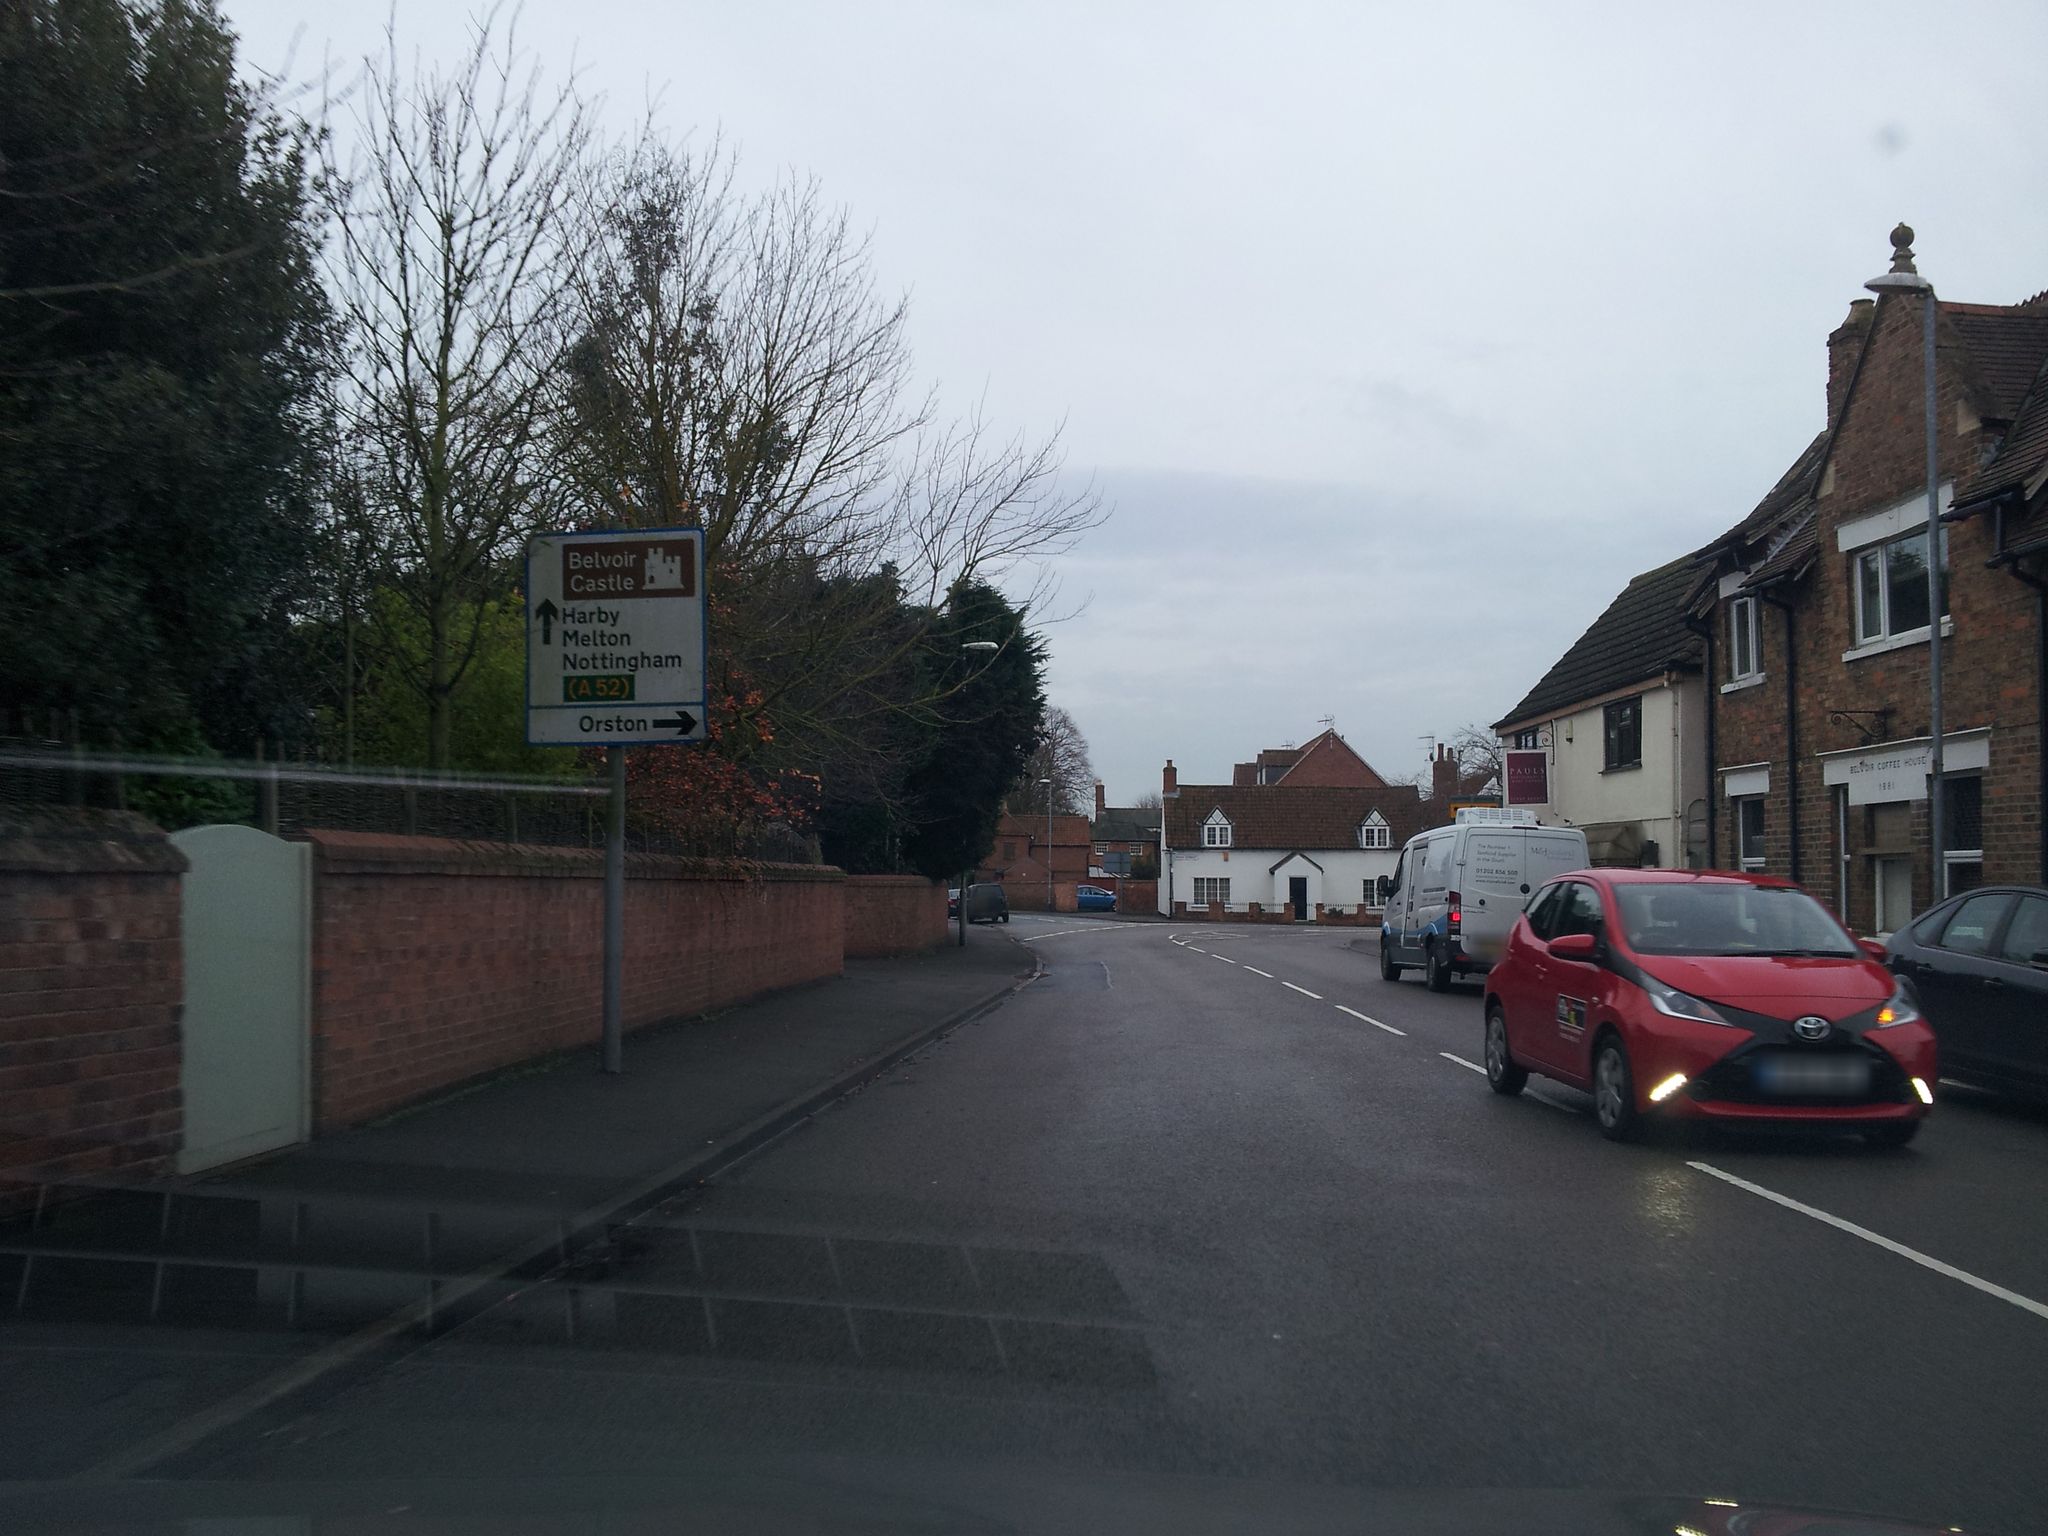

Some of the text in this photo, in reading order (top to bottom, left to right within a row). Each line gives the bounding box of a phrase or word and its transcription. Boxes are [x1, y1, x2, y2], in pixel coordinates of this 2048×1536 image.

[568, 552, 637, 569] Belvoir
[570, 574, 635, 593] Castle
[562, 606, 619, 627] Harby
[562, 629, 631, 648] Melton
[562, 651, 682, 672] Nottingham
[579, 715, 648, 733] Orston
[1877, 760, 1901, 770] COFFEE
[1904, 756, 1926, 766] HOUSE
